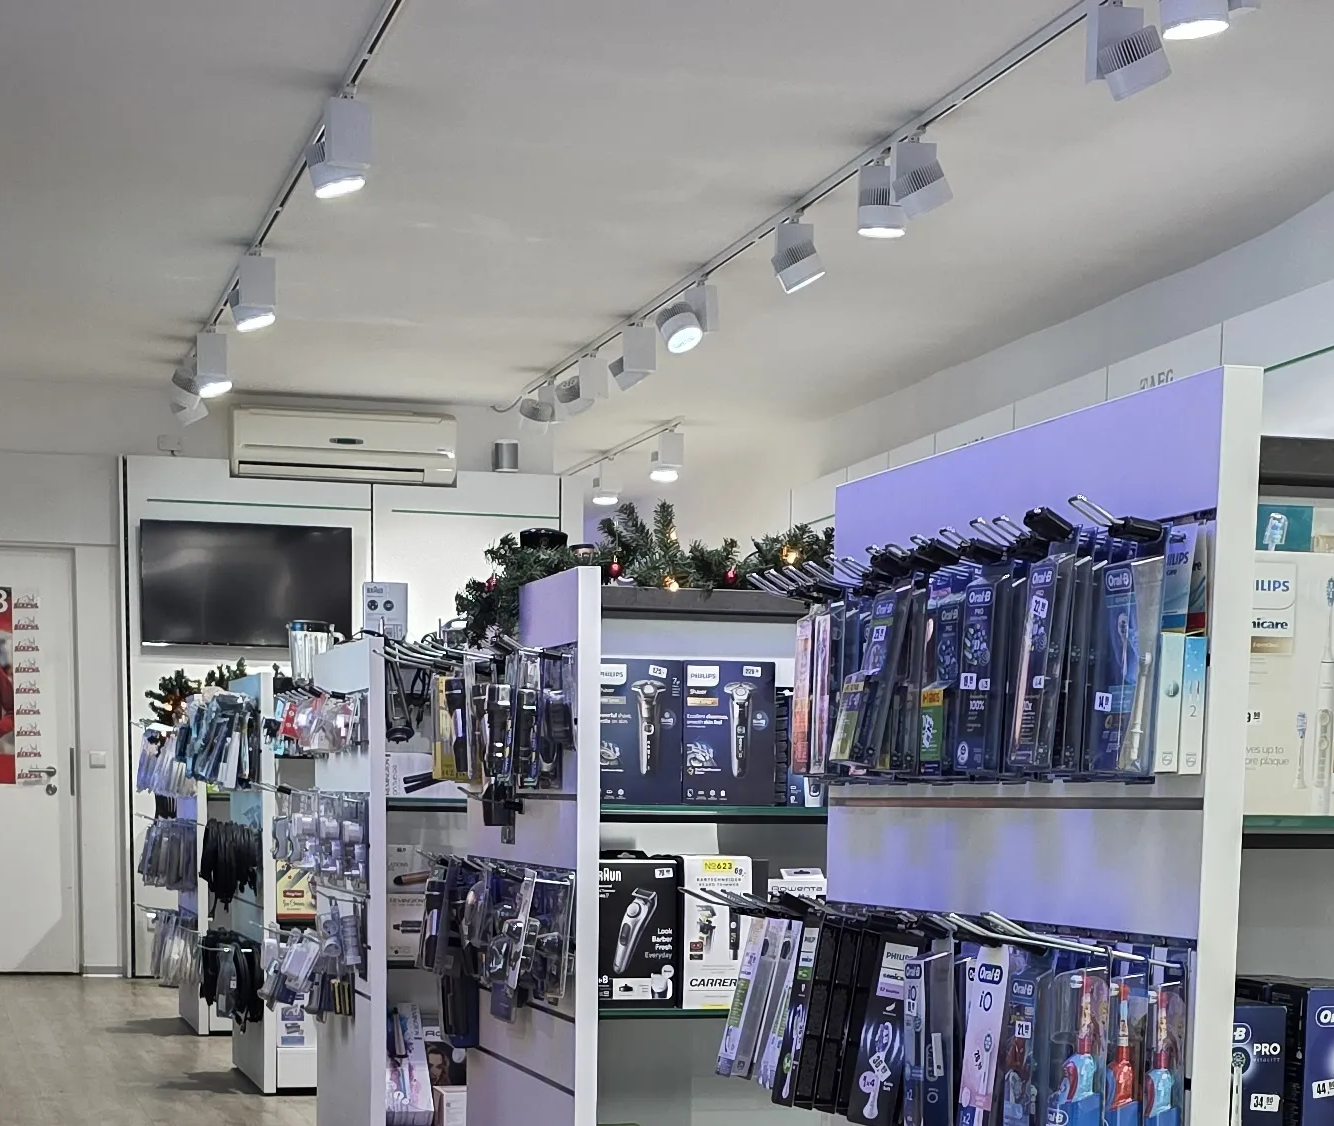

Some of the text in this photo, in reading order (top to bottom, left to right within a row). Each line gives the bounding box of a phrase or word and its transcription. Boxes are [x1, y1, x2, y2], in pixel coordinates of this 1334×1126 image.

[1151, 369, 1175, 389] AEG
[969, 591, 992, 604] Oral-B
[651, 935, 673, 944] Barber
[655, 943, 673, 951] Fresh
[644, 951, 673, 960] Everyday
[978, 965, 1002, 983] Oral-B
[1013, 982, 1034, 996] Oral-B
[979, 991, 993, 1012] iO
[1253, 1043, 1281, 1055] PRO
